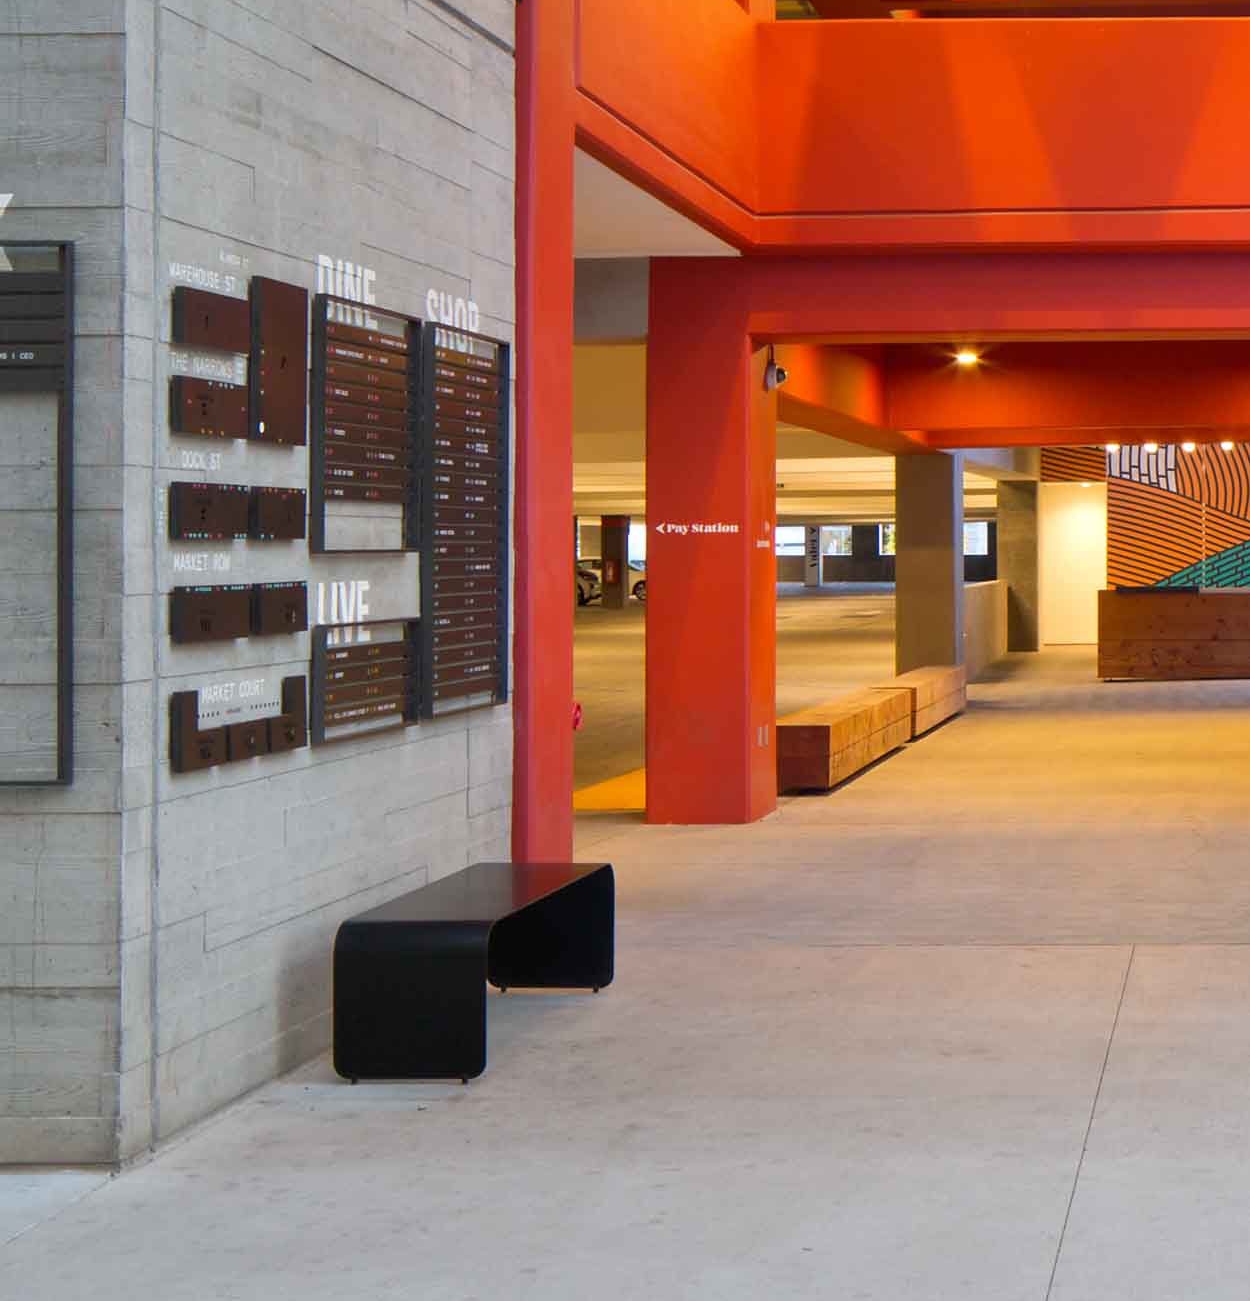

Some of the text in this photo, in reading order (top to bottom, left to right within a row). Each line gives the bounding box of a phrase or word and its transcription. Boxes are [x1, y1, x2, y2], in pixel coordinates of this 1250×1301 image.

[169, 262, 236, 292] WAREHOUSE ST
[317, 254, 378, 330] DINE
[427, 289, 479, 354] SHOP
[170, 352, 188, 373] THE
[666, 522, 739, 535] Pay Station
[174, 553, 208, 571] MARKET
[317, 581, 370, 643] LIVE
[200, 678, 265, 704] MARKET COURT
